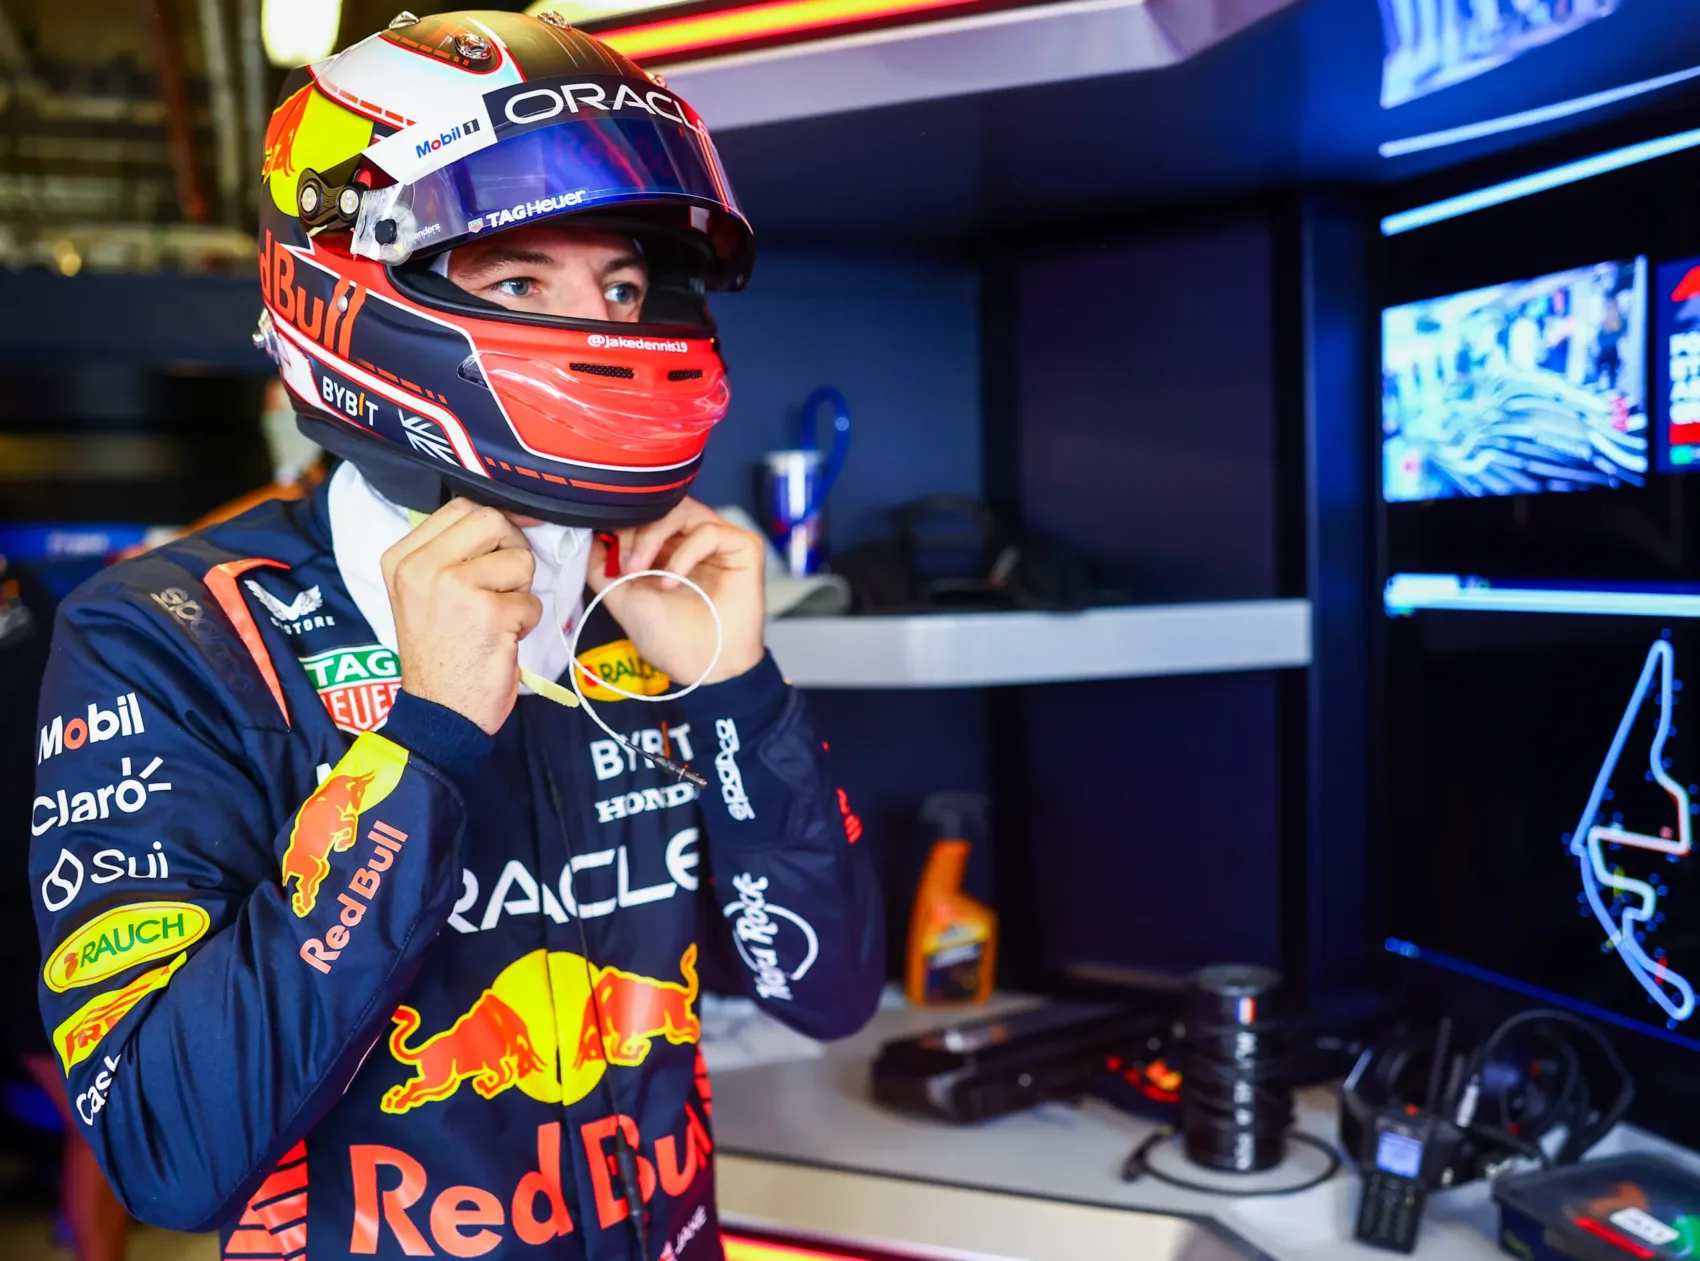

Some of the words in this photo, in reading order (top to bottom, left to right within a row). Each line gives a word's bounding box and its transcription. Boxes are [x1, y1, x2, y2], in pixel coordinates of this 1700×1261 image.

[415, 126, 461, 158] Mobil
[273, 240, 366, 360] Bull
[587, 334, 688, 353] @jakedennis19
[322, 375, 379, 426] BYBIT
[303, 651, 397, 687] TAG
[37, 692, 145, 765] Mobil
[31, 779, 147, 836] Claro
[594, 782, 698, 823] HOND
[90, 841, 168, 884] Sui
[447, 828, 699, 933] RACLE
[300, 893, 367, 974] Red
[348, 820, 409, 900] Bull
[732, 872, 778, 945] Rock
[79, 914, 184, 968] RAUCH
[349, 1122, 574, 1258] Red
